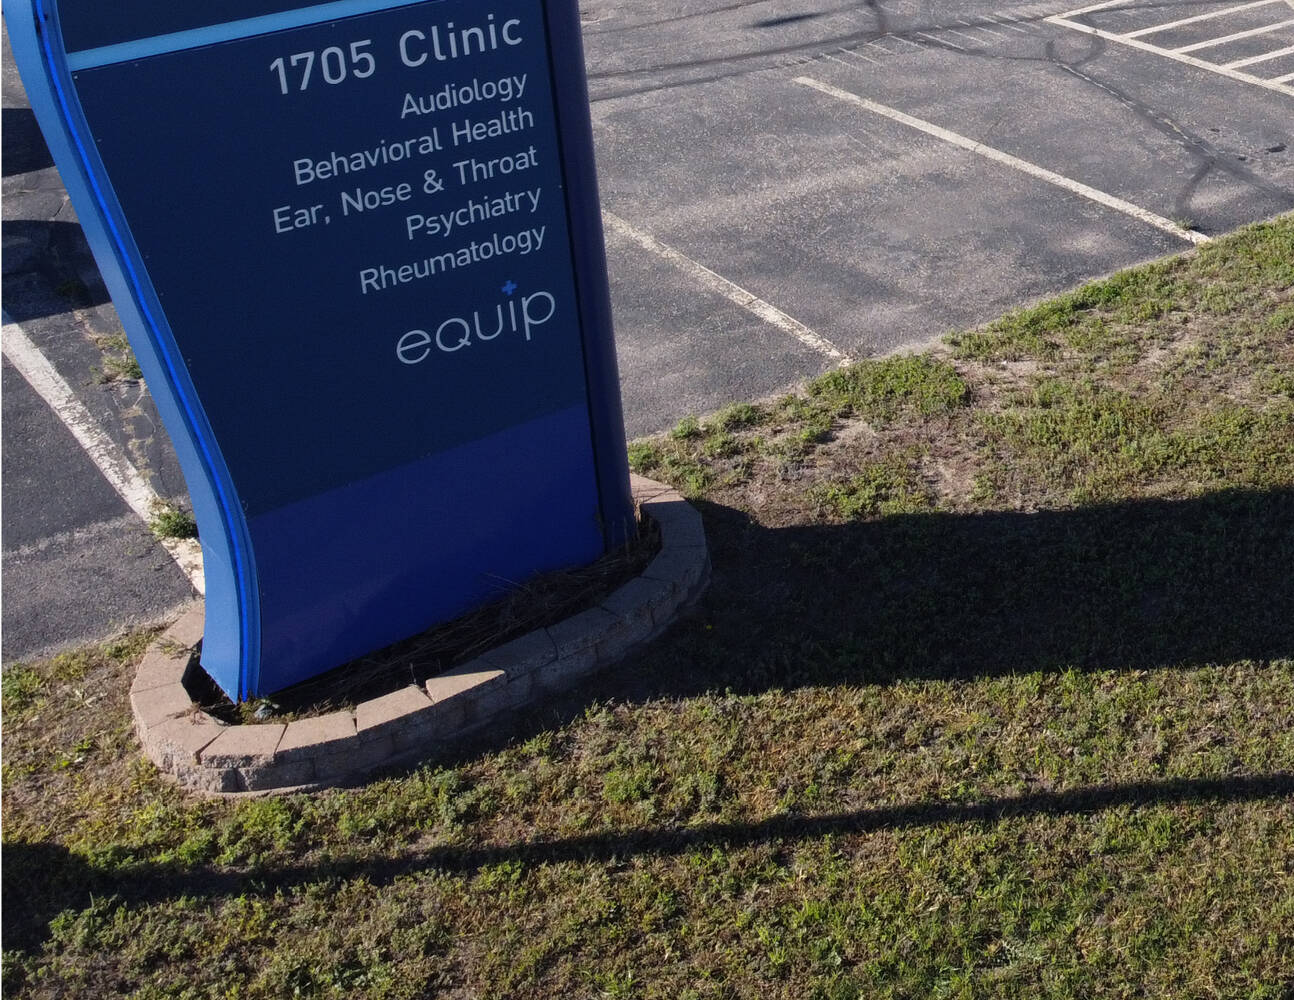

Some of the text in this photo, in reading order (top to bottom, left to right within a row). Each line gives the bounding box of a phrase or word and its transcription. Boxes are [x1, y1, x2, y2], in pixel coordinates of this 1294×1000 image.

[269, 14, 523, 96] 1705 Clinic
[400, 73, 528, 119] Audiology
[293, 106, 534, 186] Behavioral Health
[273, 145, 538, 234] Ear, Nose & Throat
[406, 187, 543, 241] Psychiatry
[359, 225, 547, 295] Rheumatology
[396, 290, 556, 365] equip
